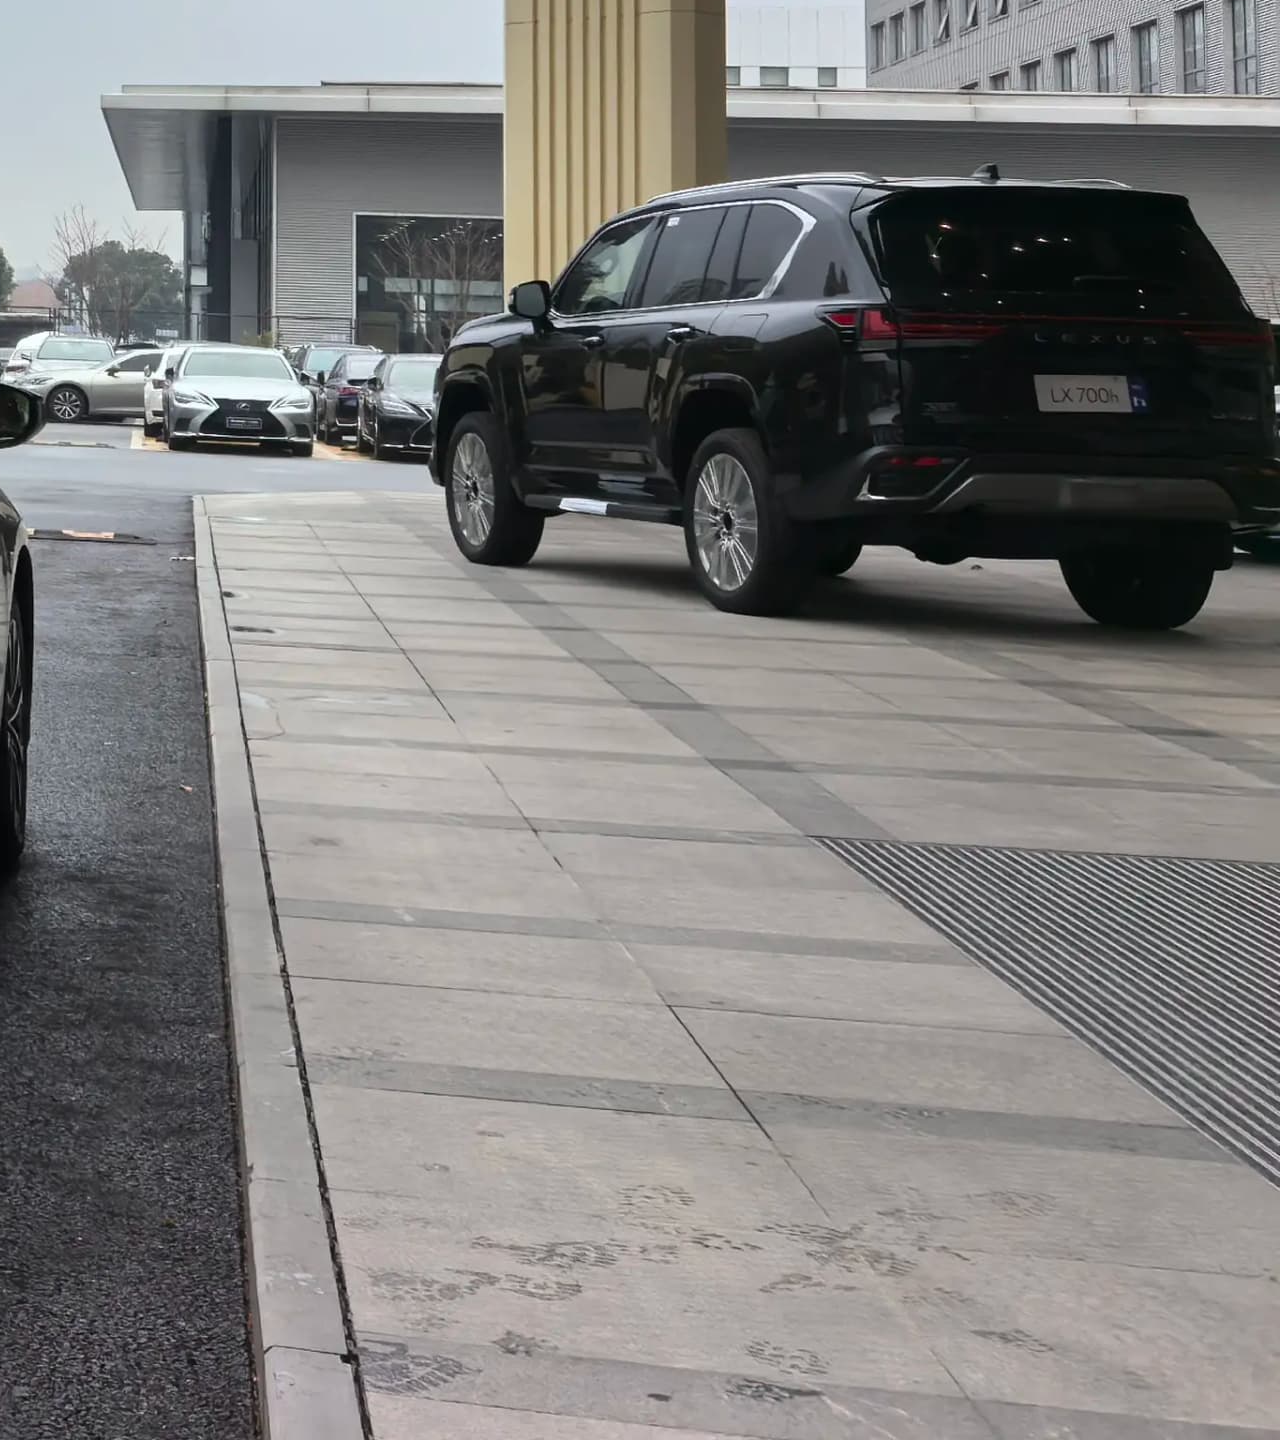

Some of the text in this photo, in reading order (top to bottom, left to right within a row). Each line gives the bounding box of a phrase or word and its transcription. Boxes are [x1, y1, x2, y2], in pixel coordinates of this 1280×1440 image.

[1033, 331, 1157, 344] LEXUS
[1050, 386, 1120, 404] LX 700h
